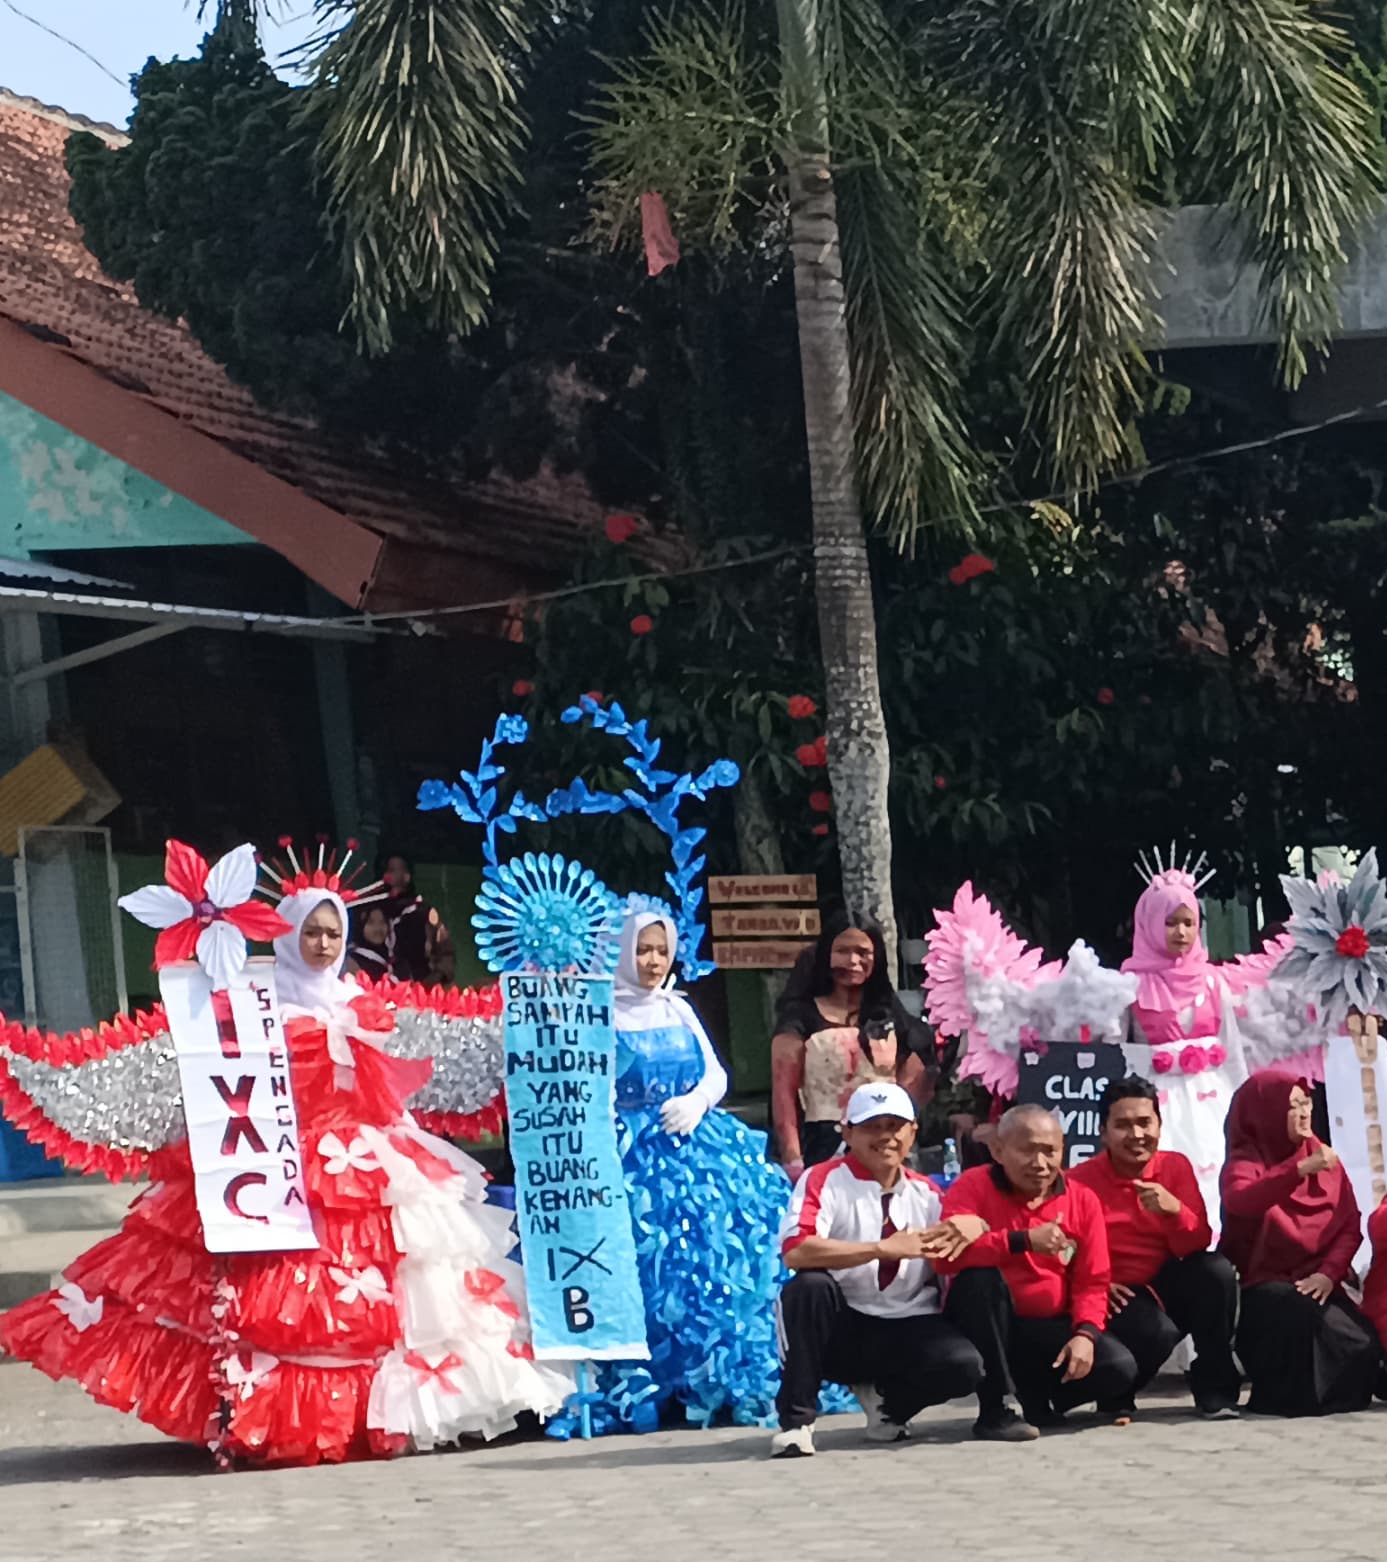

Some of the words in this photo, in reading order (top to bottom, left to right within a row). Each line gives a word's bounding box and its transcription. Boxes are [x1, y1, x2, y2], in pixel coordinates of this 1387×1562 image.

[507, 976, 590, 1000] BUANG
[508, 1002, 609, 1027] SAMPAH
[536, 1024, 579, 1048] ITU
[507, 1049, 608, 1076] MUDAH
[527, 1080, 593, 1104] YANG
[513, 1106, 586, 1132] SUSAH
[542, 1131, 583, 1156] ITU
[527, 1158, 599, 1186] BUANG
[531, 1215, 560, 1236] AN
[547, 1237, 613, 1282] IX
[563, 1286, 594, 1333] B
